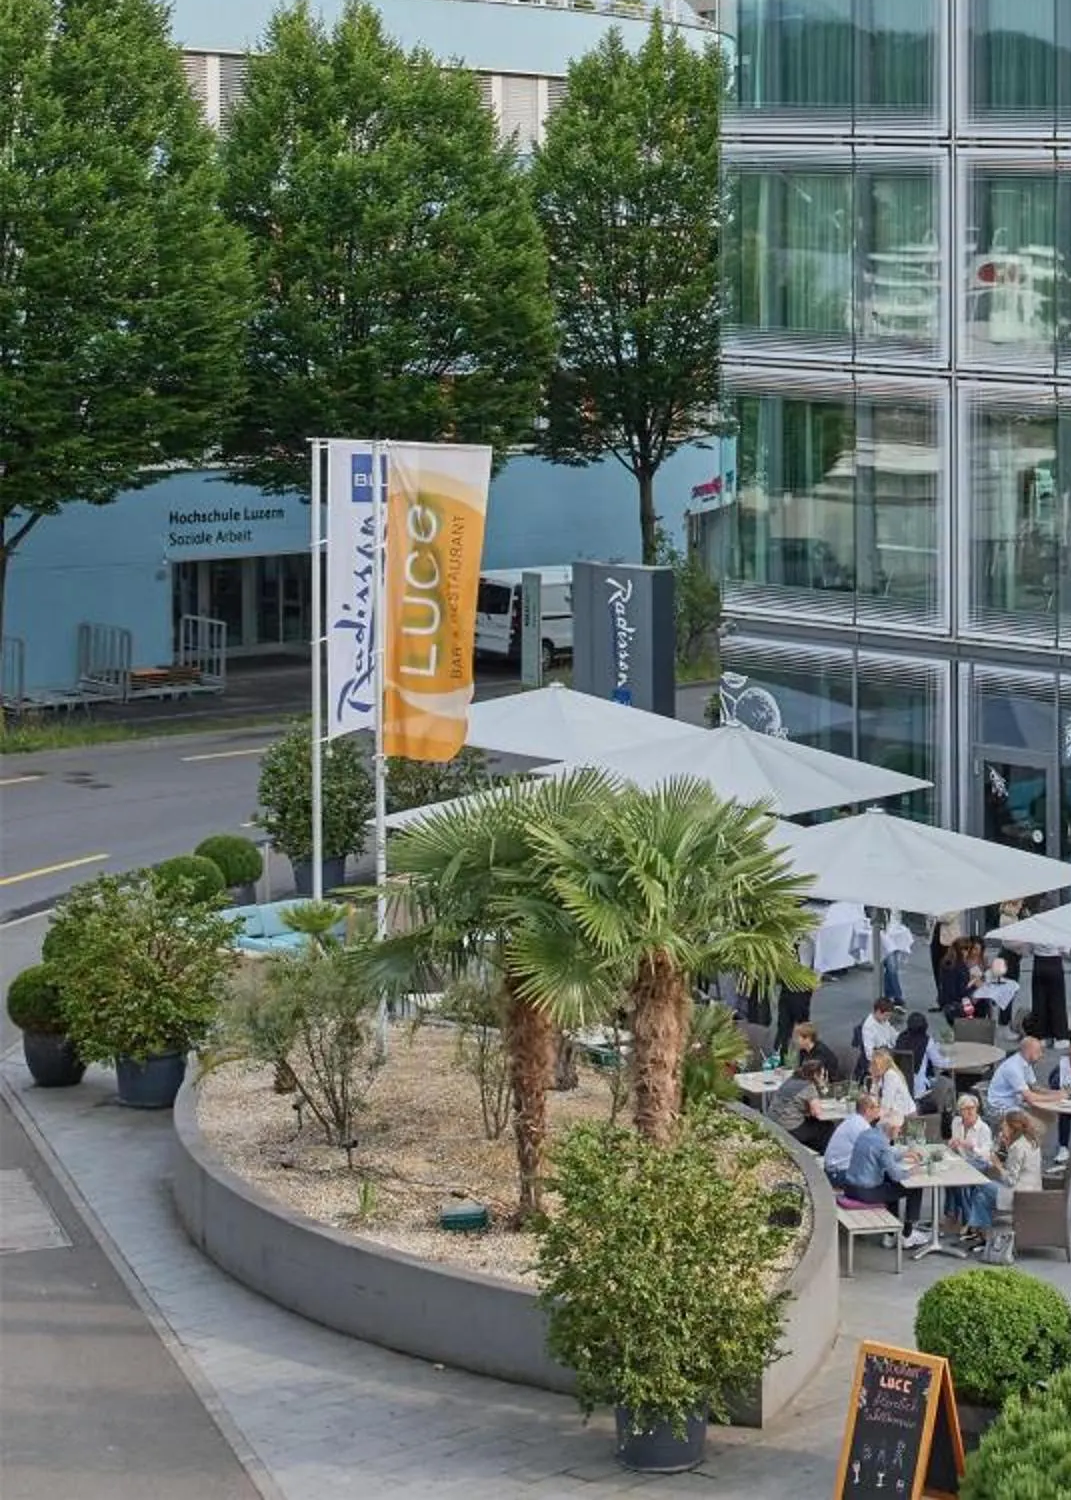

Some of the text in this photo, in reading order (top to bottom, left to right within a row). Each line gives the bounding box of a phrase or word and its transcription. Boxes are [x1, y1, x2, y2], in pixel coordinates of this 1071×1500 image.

[169, 507, 285, 524] Hochschule Luzern
[169, 529, 252, 546] Soziale Arbeit
[605, 577, 637, 688] Radisson
